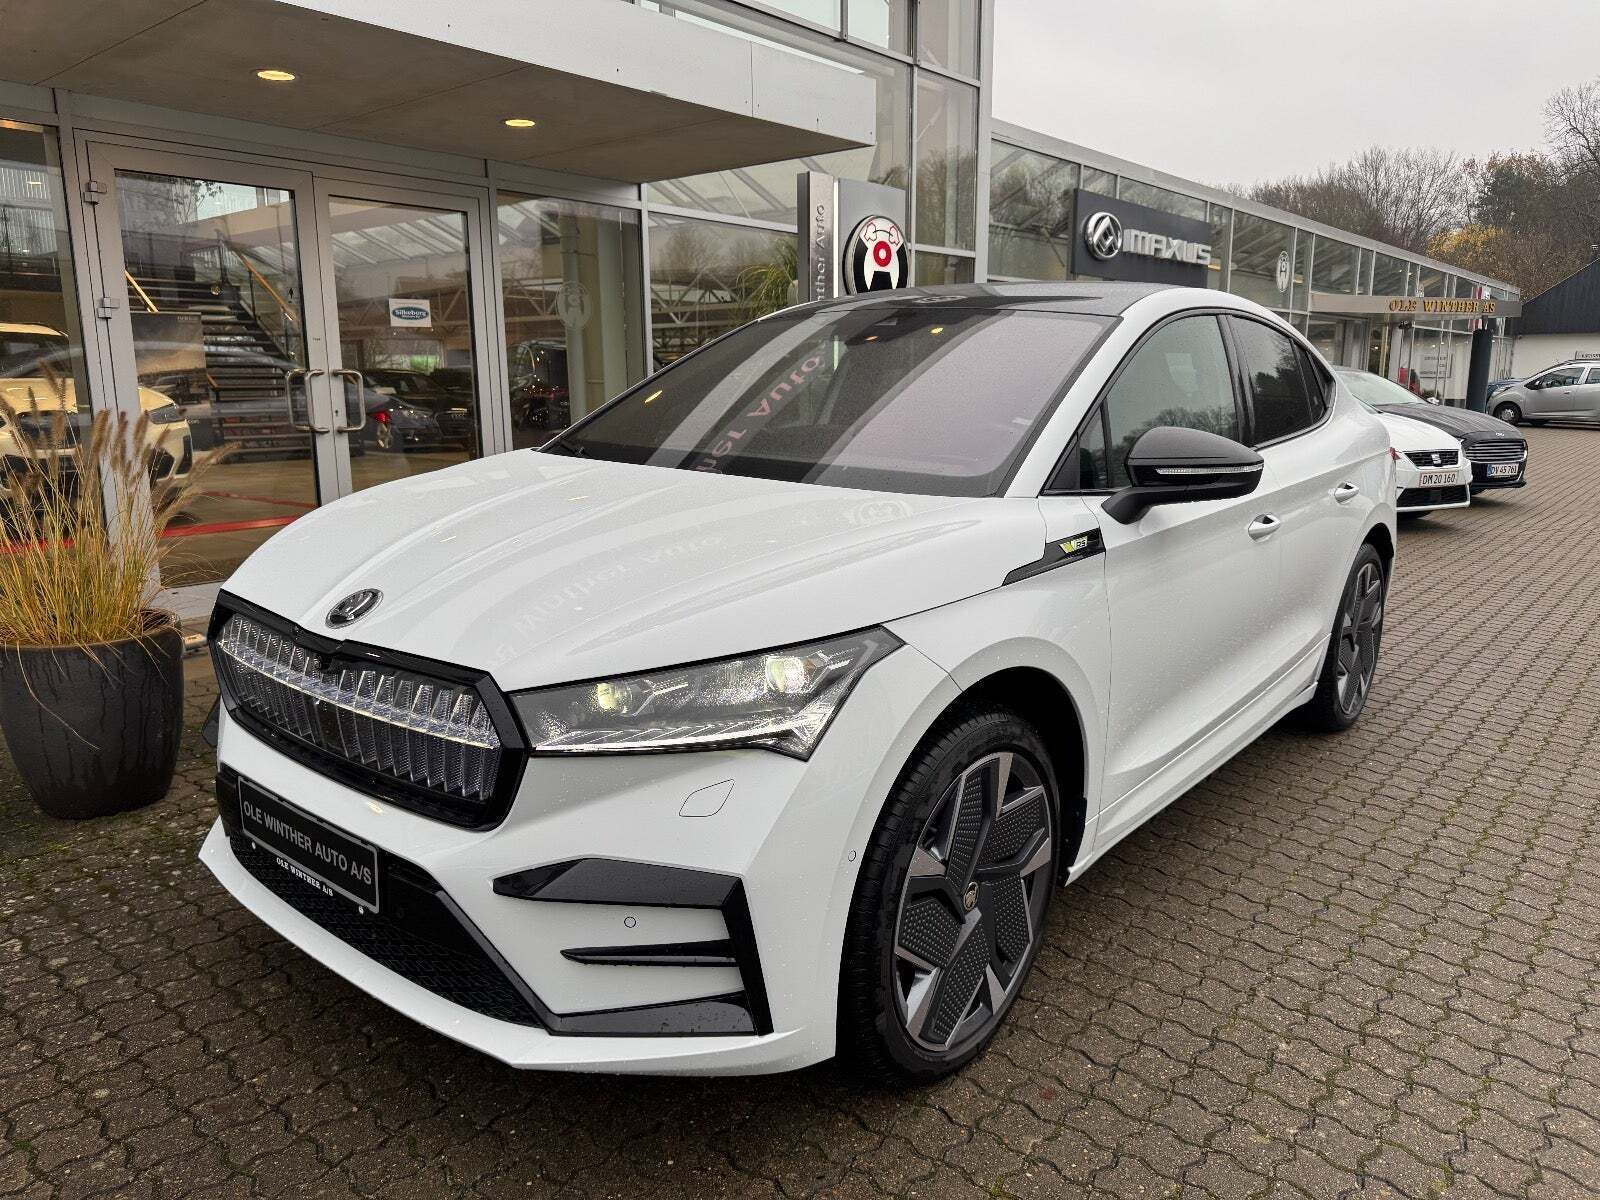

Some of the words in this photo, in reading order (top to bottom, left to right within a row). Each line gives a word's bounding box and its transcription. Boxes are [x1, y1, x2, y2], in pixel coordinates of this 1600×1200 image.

[816, 204, 825, 248] Auto
[1123, 228, 1212, 265] MAXUS
[1389, 300, 1417, 312] OLE
[1423, 300, 1479, 313] WINTHER
[1422, 474, 1433, 484] DM
[1434, 474, 1442, 484] 20
[1444, 473, 1456, 483] 160
[243, 801, 263, 825] OLE
[264, 811, 313, 854] WINTHER
[315, 840, 348, 872] AUTO
[350, 862, 372, 885] A/S
[276, 857, 289, 871] OLE
[290, 864, 321, 889] WINTHER
[322, 885, 334, 897] A/S
